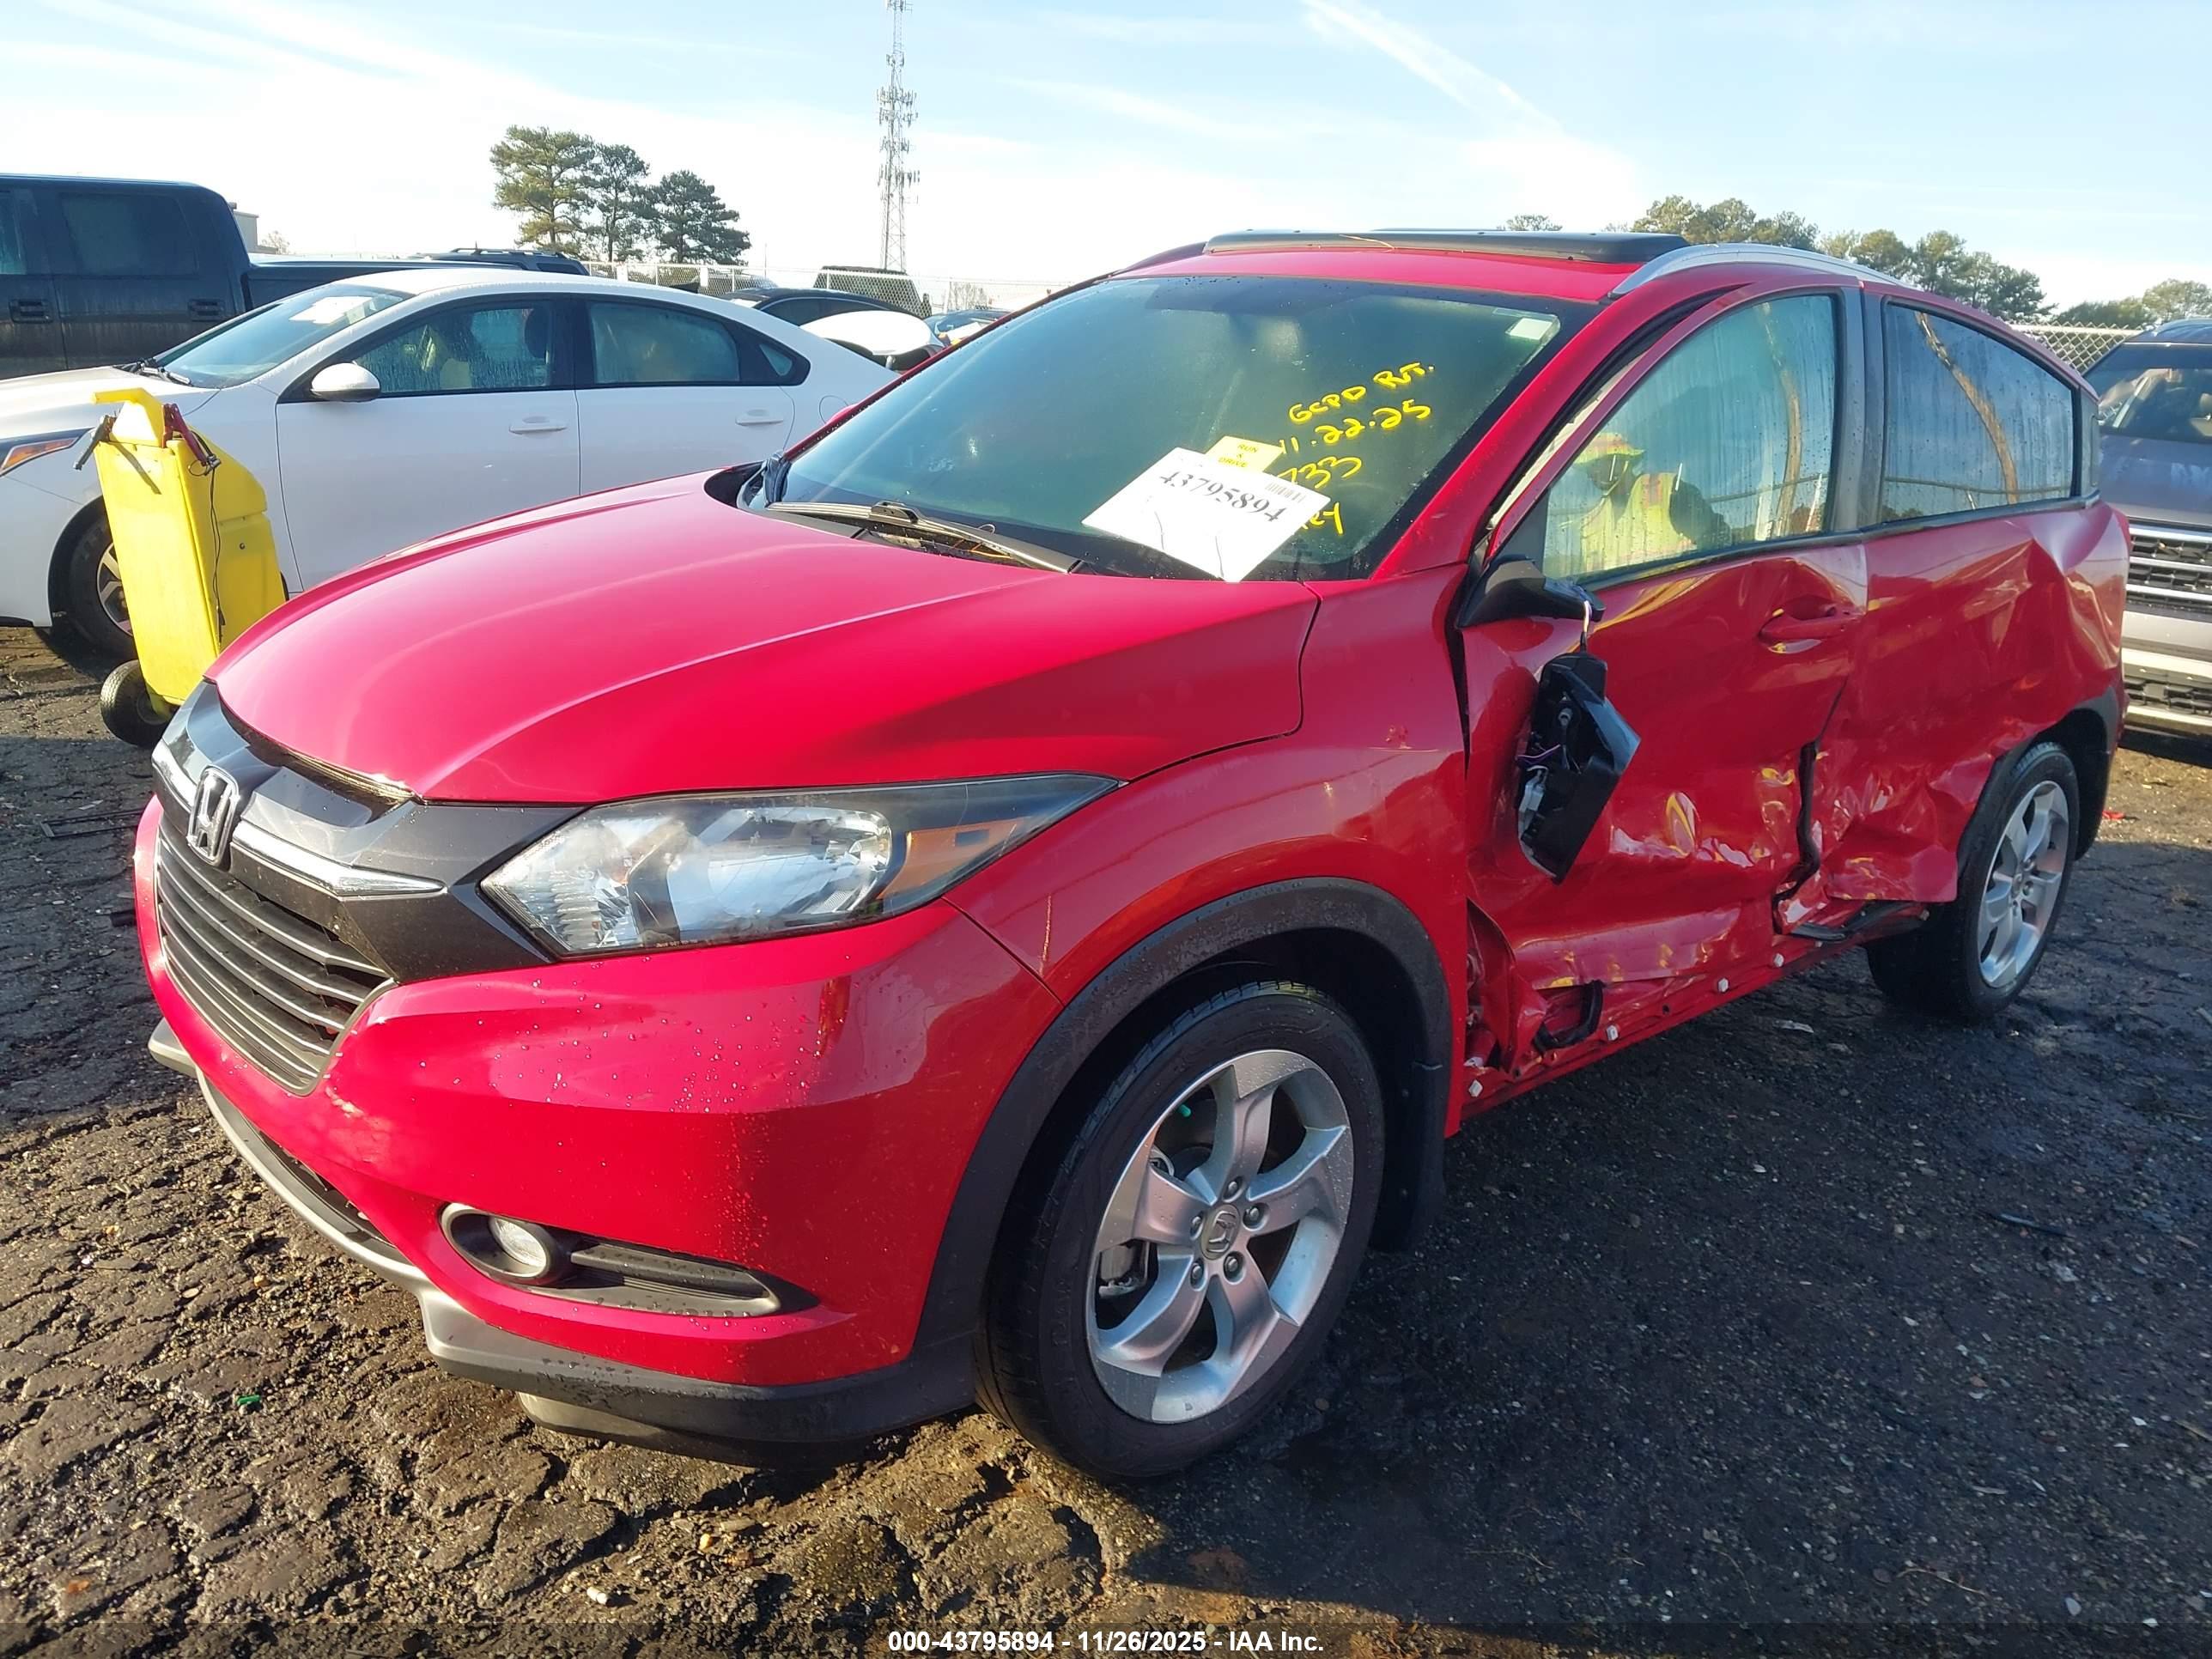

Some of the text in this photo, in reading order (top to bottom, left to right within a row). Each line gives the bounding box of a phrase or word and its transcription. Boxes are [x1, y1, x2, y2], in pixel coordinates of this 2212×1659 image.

[1289, 386, 1367, 422] GCPD
[1279, 398, 1431, 454] 11.22.25
[1218, 456, 1248, 468] DRIVE
[1237, 443, 1259, 453] RUN
[1159, 471, 1287, 522] 43795894
